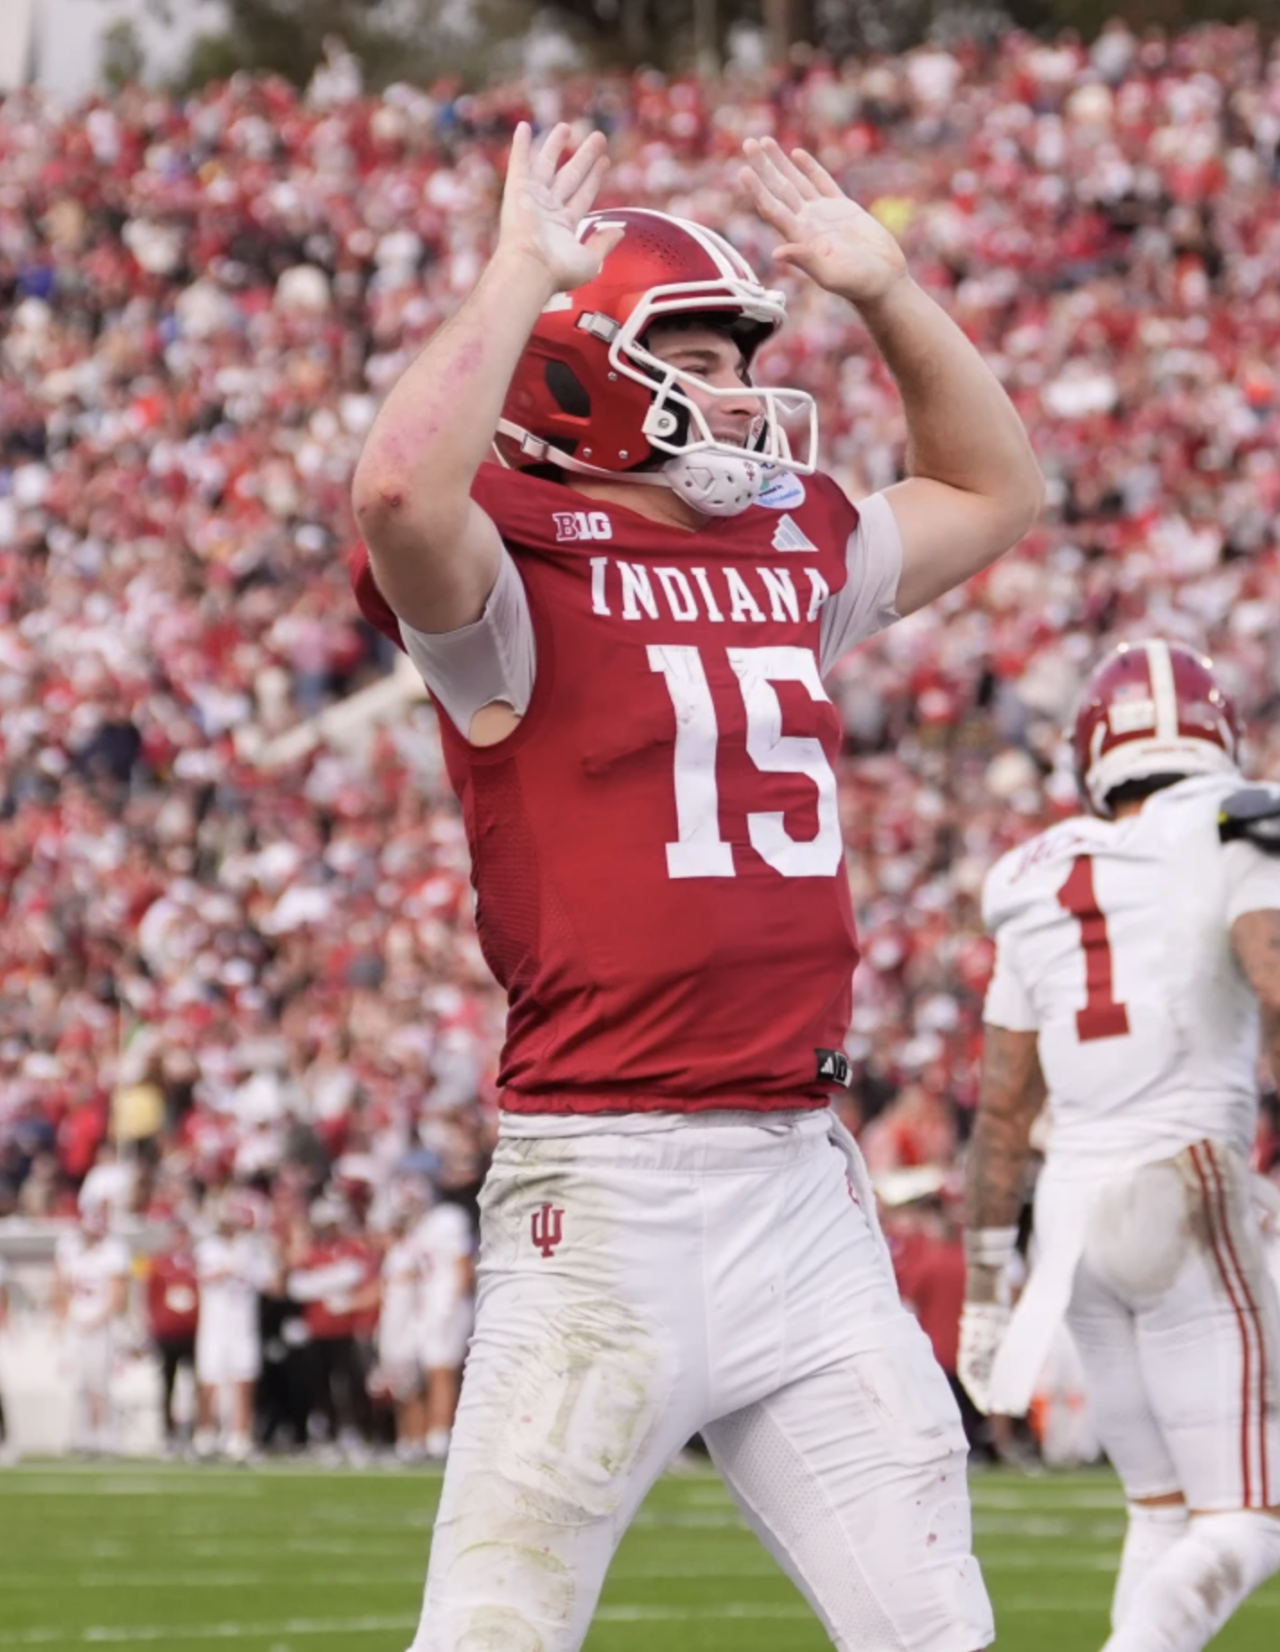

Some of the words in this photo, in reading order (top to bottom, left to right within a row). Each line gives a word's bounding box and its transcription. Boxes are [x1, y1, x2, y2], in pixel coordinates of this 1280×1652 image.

[590, 557, 830, 623] INDIANA
[646, 645, 843, 878] 15
[1057, 854, 1130, 1045] 1
